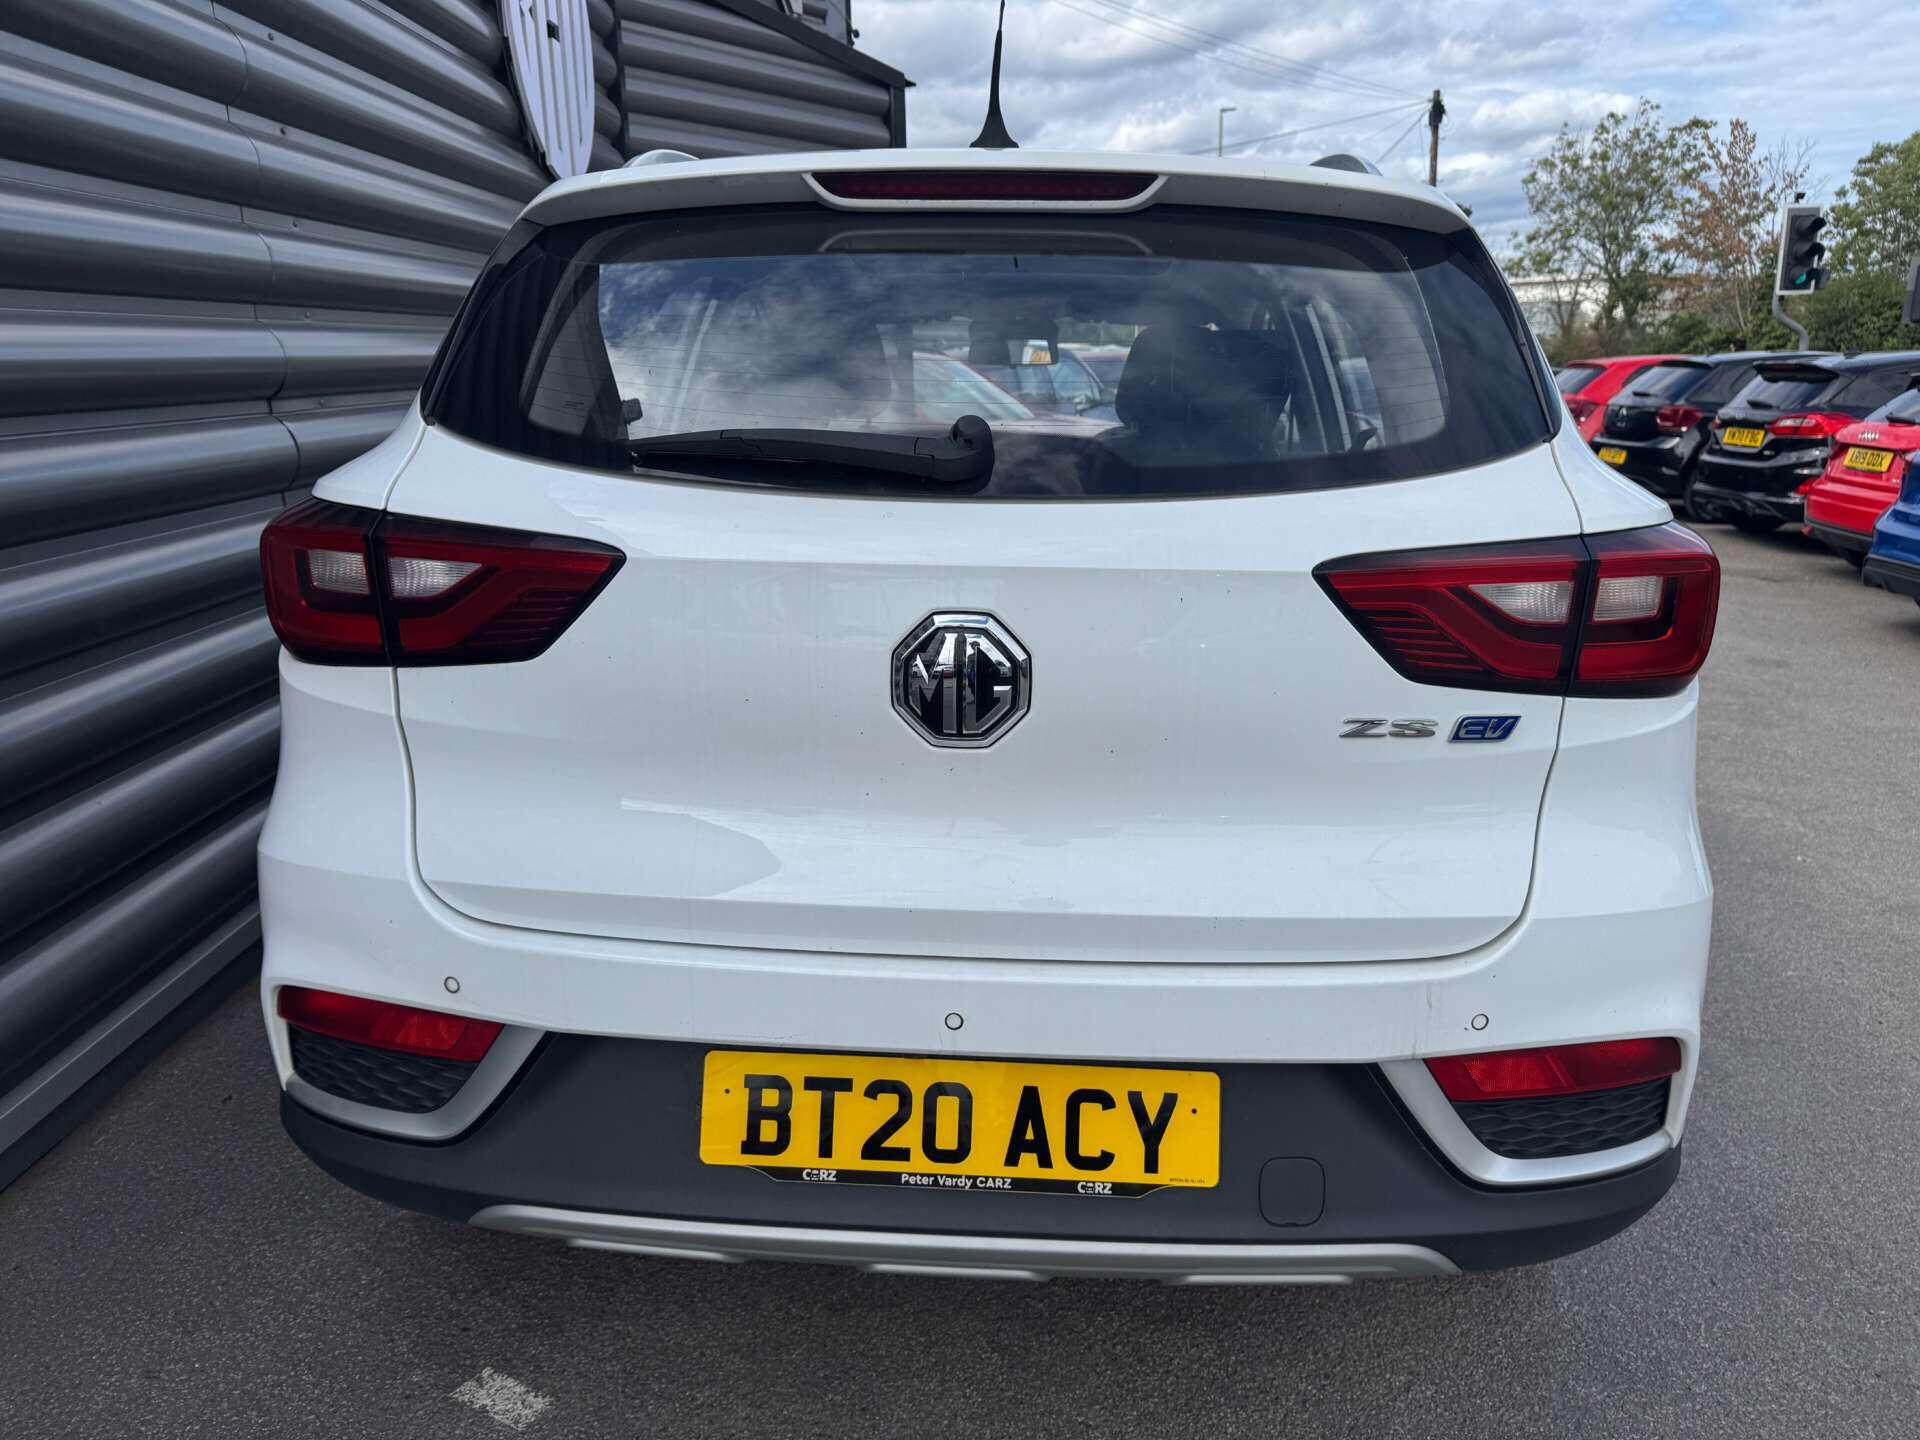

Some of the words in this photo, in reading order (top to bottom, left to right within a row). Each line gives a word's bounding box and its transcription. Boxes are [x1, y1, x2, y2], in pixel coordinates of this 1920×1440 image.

[909, 632, 1012, 734] MG
[1339, 718, 1438, 738] ZS
[1458, 718, 1517, 740] EV
[740, 1073, 974, 1165] BT20
[1004, 1085, 1178, 1175] ACY
[901, 1173, 935, 1186] Peter
[937, 1175, 973, 1190] Vardy
[976, 1177, 1013, 1189] CARZ
